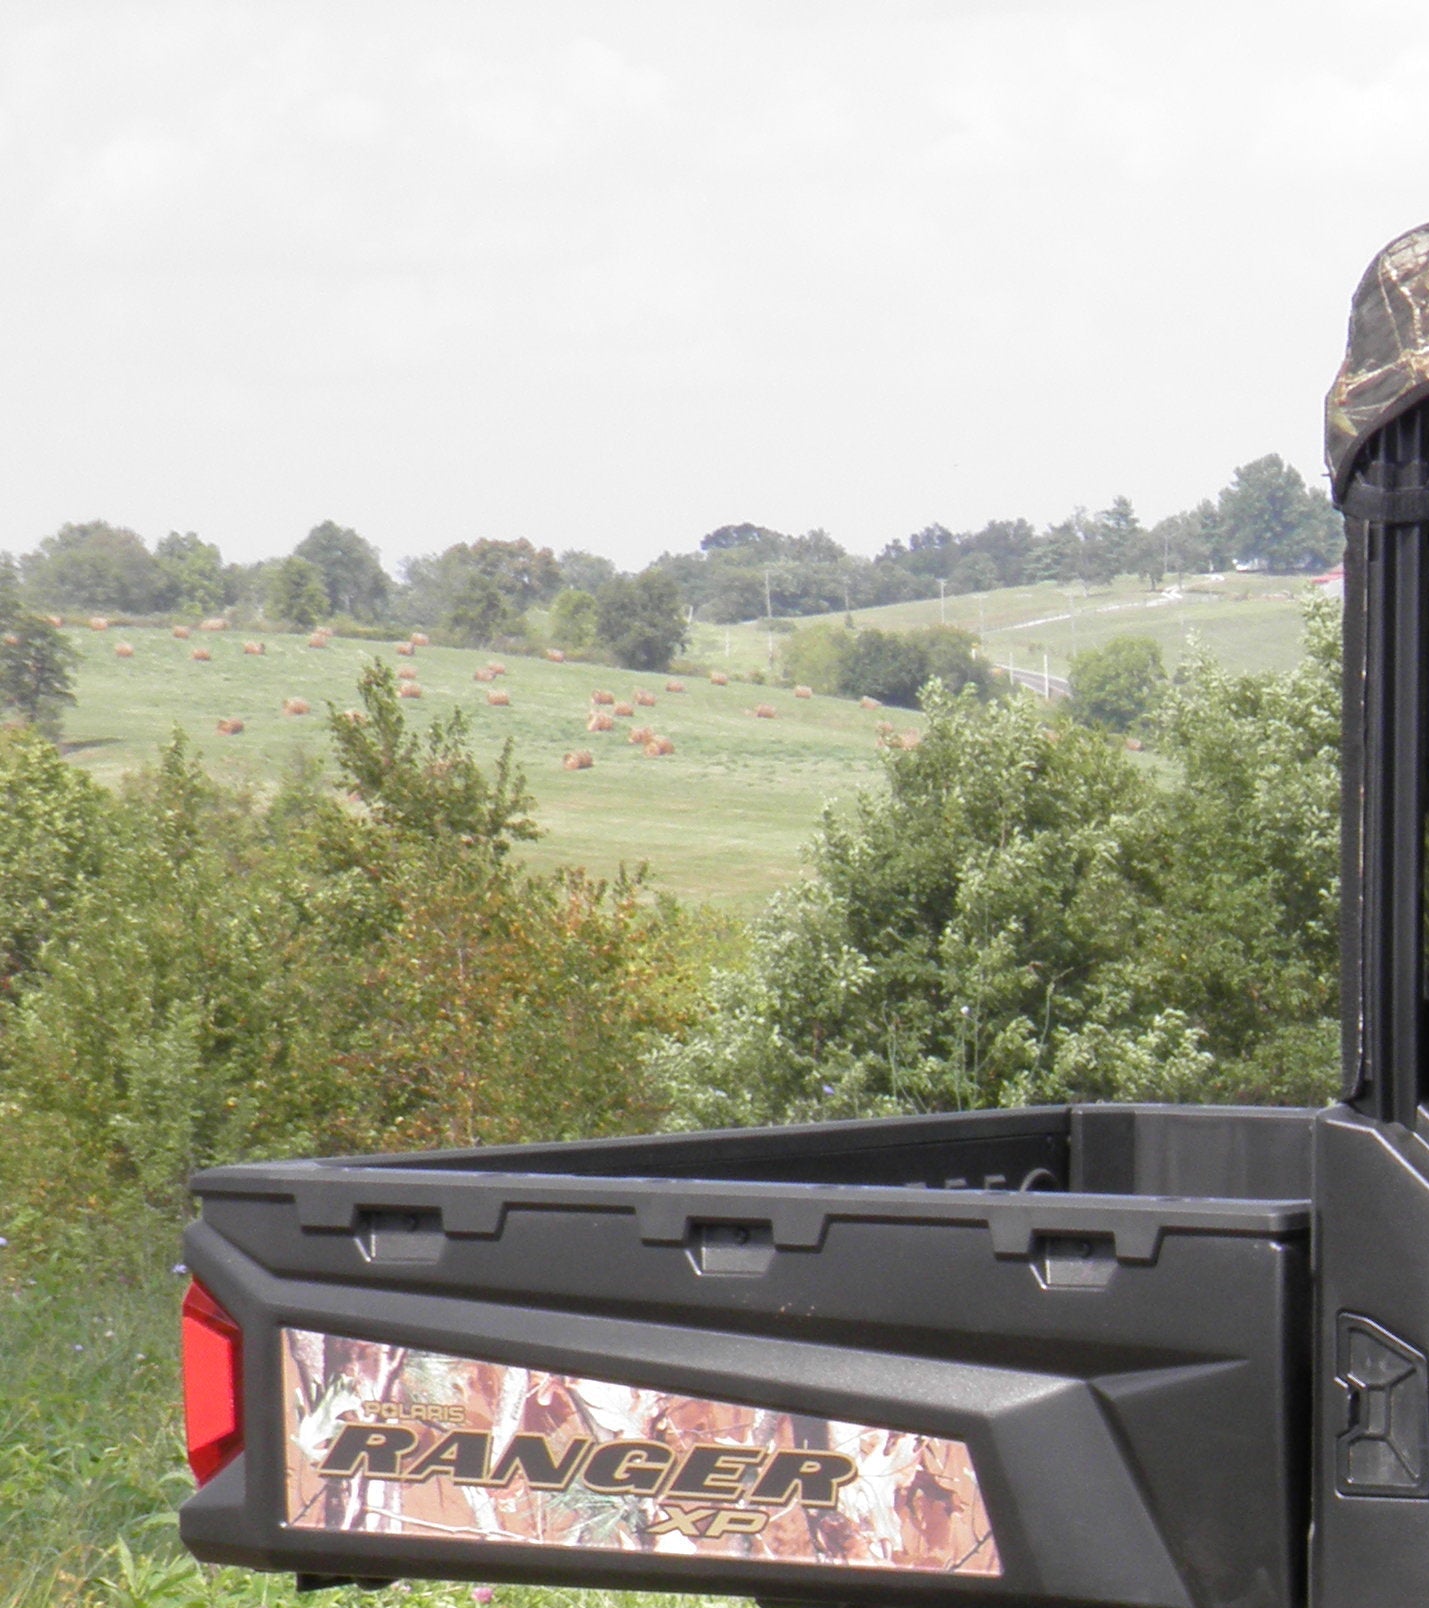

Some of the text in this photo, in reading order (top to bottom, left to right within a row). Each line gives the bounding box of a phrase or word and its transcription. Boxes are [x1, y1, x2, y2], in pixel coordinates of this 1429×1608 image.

[361, 1400, 466, 1423] POLARIS
[320, 1424, 857, 1506] RANGER
[650, 1506, 769, 1537] XP
